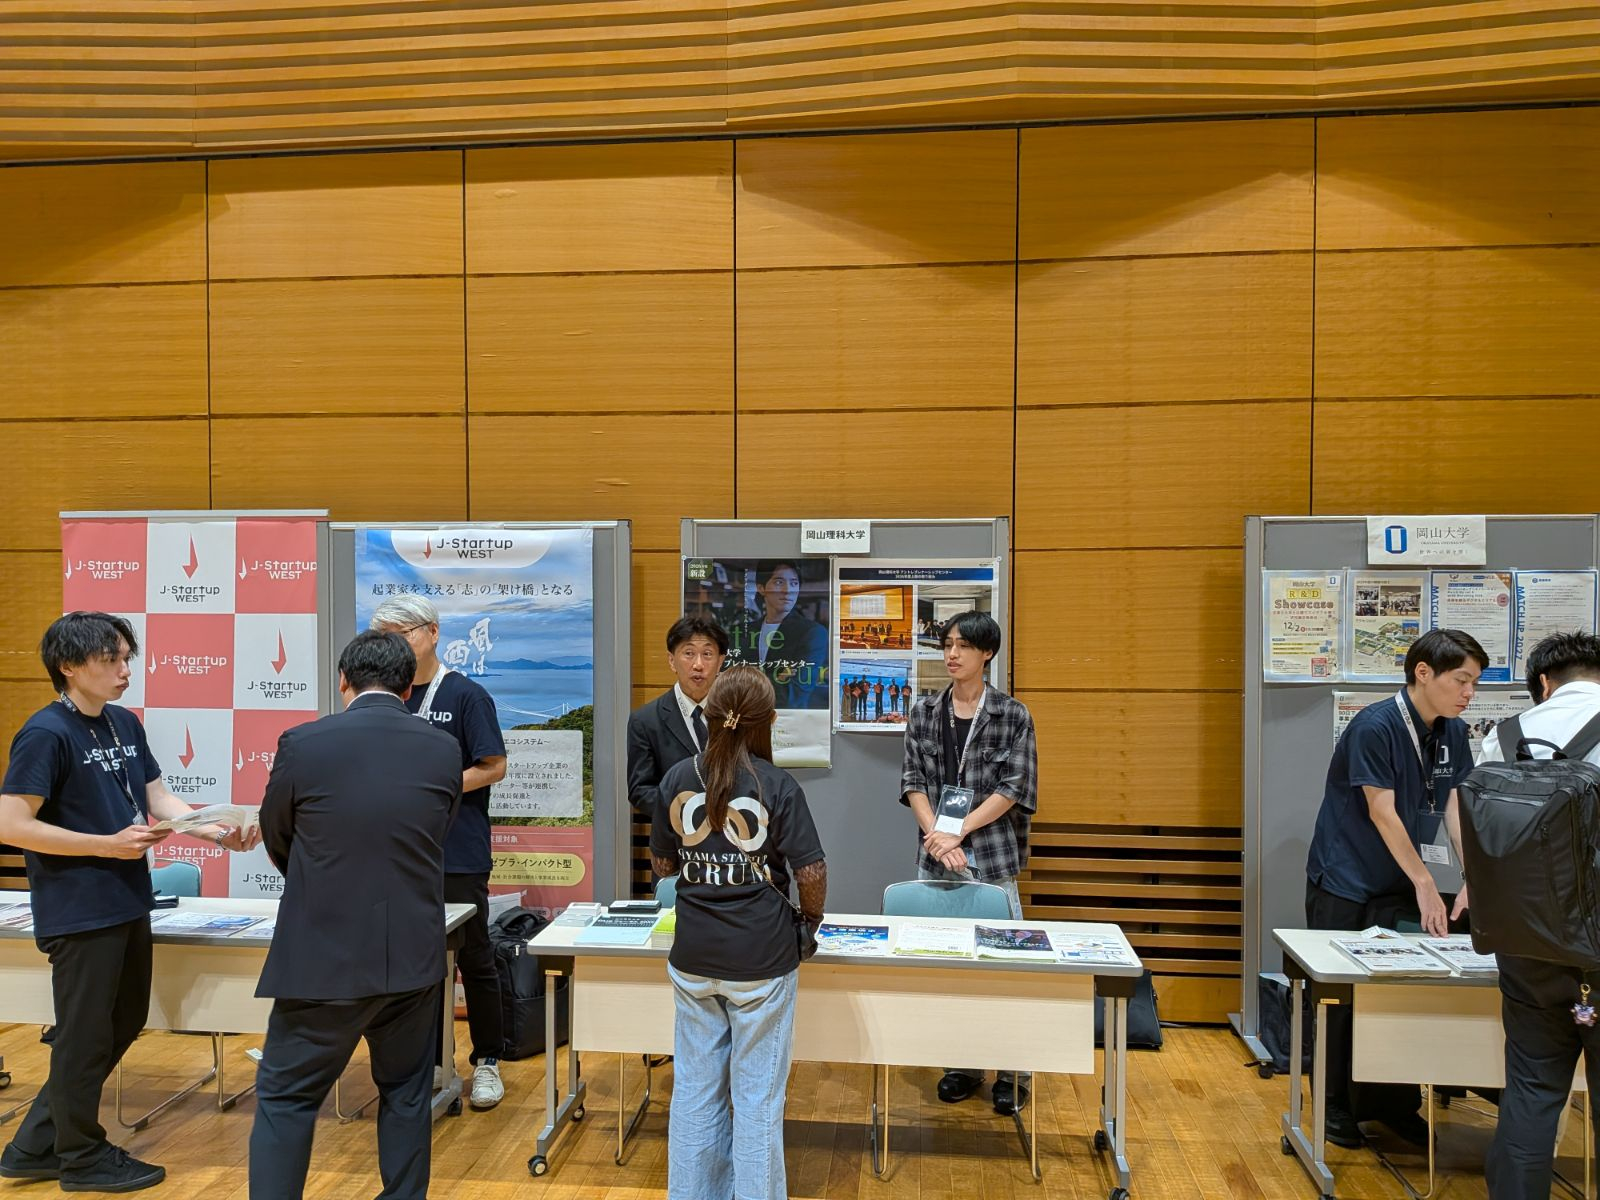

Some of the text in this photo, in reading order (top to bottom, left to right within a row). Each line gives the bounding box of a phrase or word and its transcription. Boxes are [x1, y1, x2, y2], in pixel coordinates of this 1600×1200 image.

[806, 530, 866, 540] 岡山理科大学
[1416, 526, 1470, 539] 岡山大学
[436, 538, 513, 550] J-Startup
[457, 550, 494, 559] WEST
[75, 560, 140, 572] J-Startup
[251, 560, 318, 572] J-Startup
[92, 571, 124, 579] WEST
[268, 571, 302, 579] WEST
[160, 586, 220, 596] J-Startup
[372, 583, 573, 596] 起業家を支える「志」の「架け橋」となる
[175, 594, 206, 602] WEST
[1516, 586, 1526, 618] MATCH
[1274, 599, 1334, 609] Showcase
[726, 648, 742, 657] 大学
[160, 655, 226, 666] J-Startup
[177, 666, 210, 674] WEST
[762, 666, 829, 686] eur
[248, 681, 307, 691] J-Startup
[264, 690, 293, 698] WEST
[160, 776, 216, 786] -Startup
[156, 846, 222, 858] J-Startup
